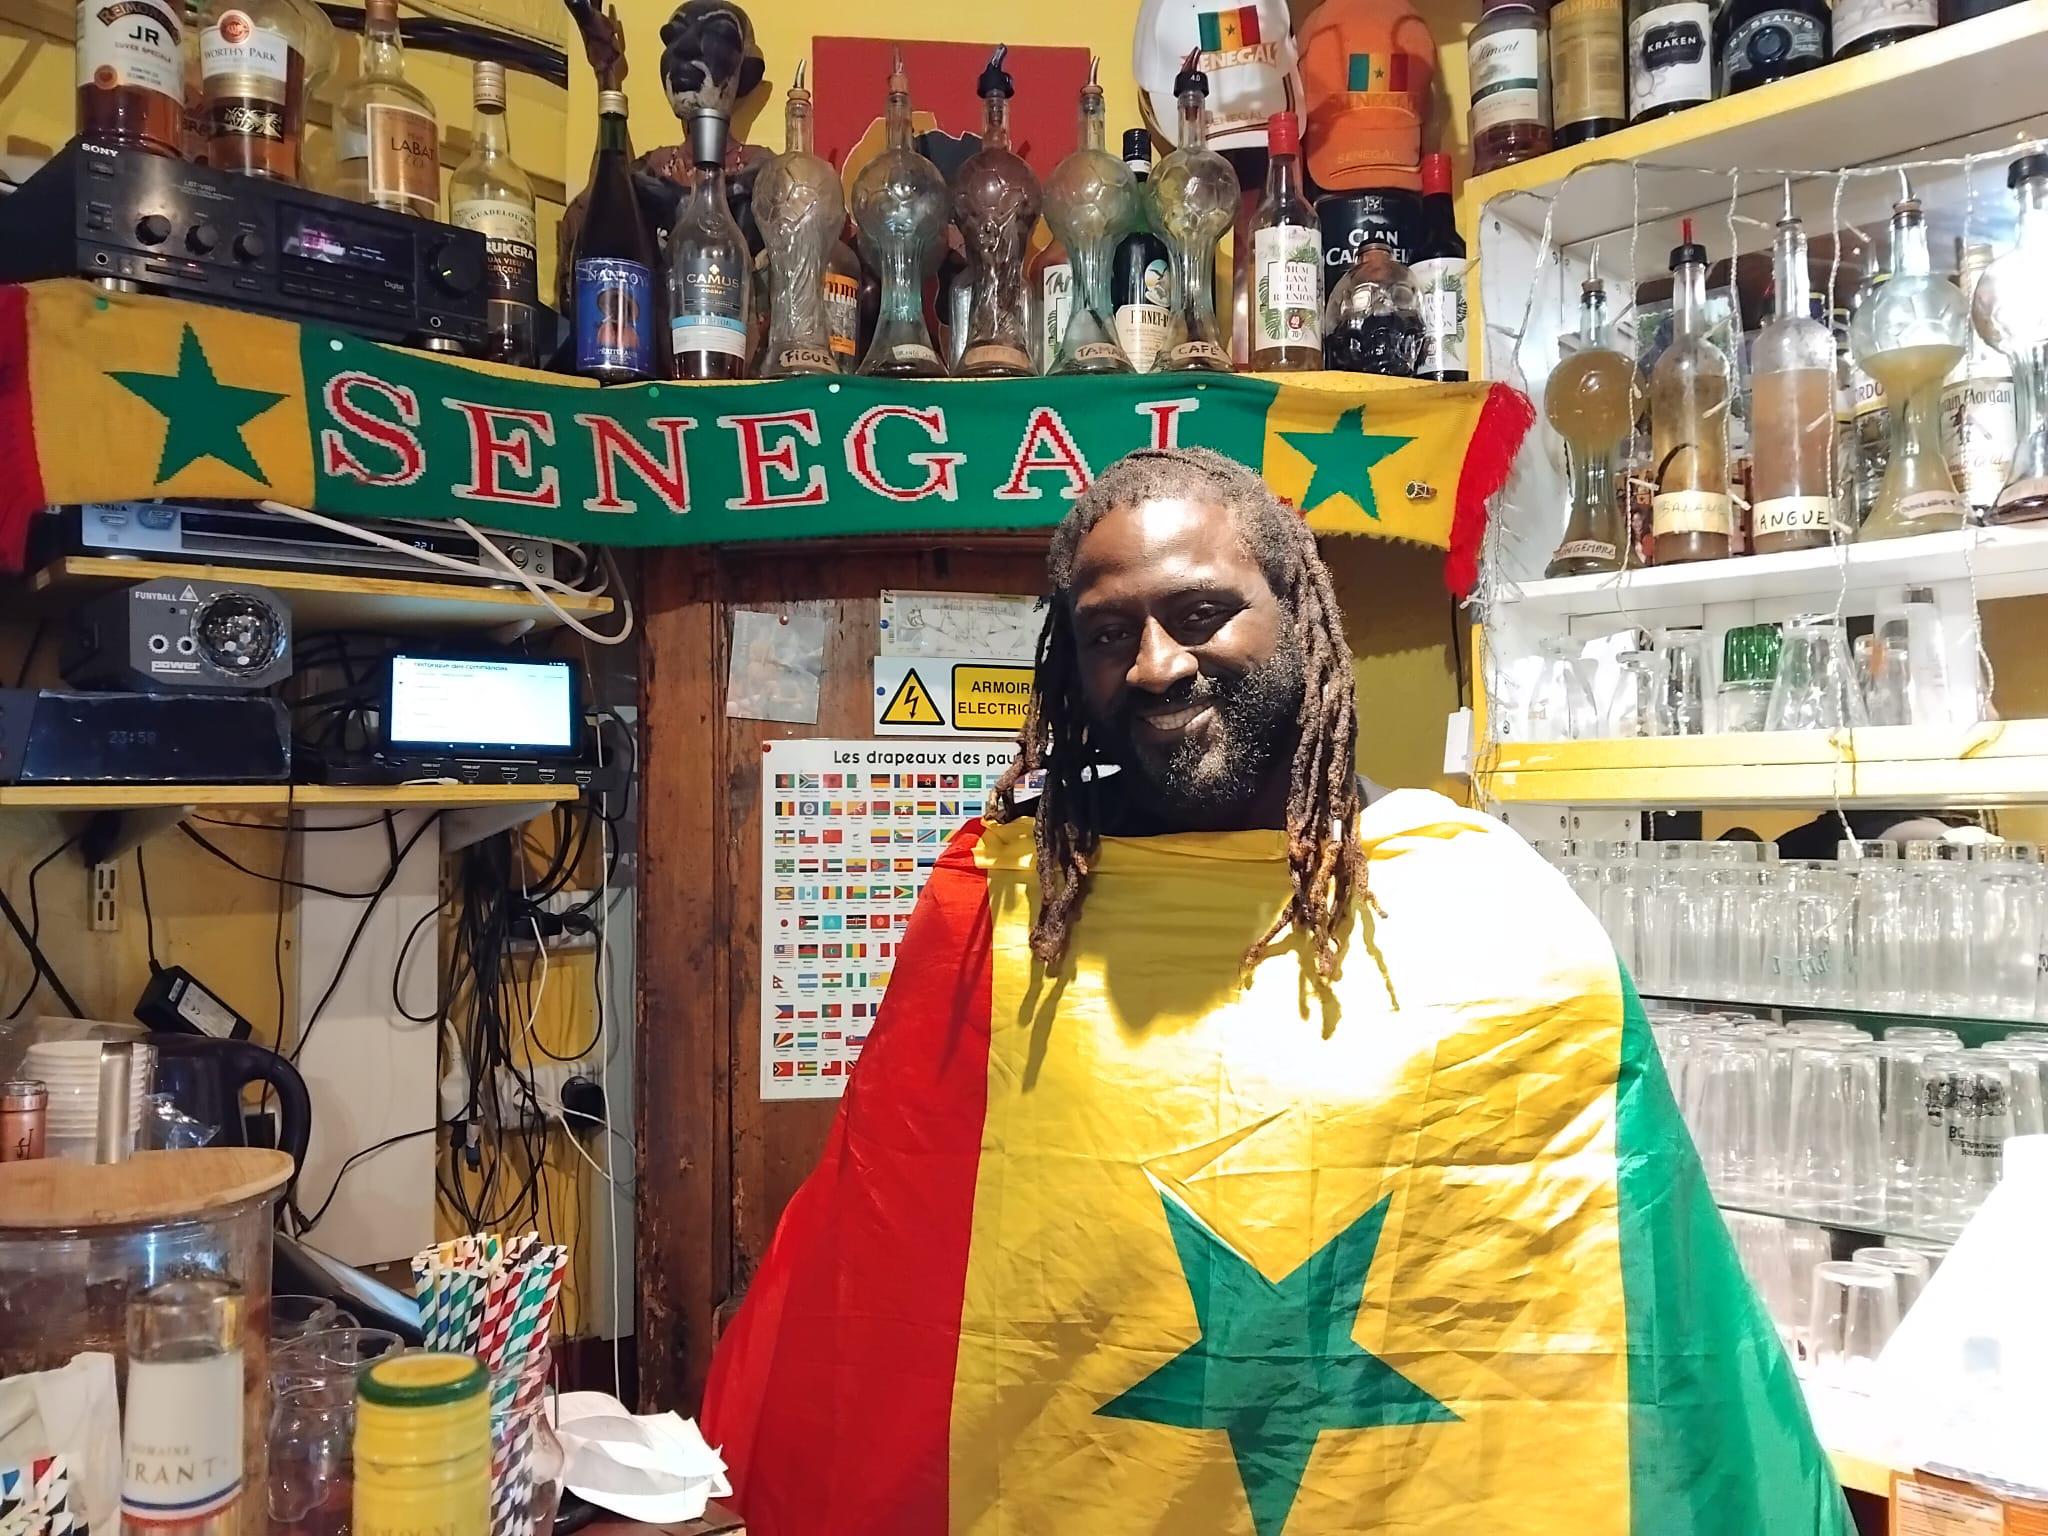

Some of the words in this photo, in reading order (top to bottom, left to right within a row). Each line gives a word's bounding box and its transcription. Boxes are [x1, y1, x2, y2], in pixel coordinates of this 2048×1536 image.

[129, 25, 159, 46] JR
[1647, 36, 1697, 53] KRAKEN
[204, 47, 246, 60] WORTHY
[249, 47, 279, 63] PARK
[1199, 42, 1278, 70] ENEGAL
[81, 142, 119, 158] SONY
[470, 208, 529, 226] GUADELOUPE
[686, 273, 740, 289] CAMUS
[700, 288, 727, 296] COGNAC
[1759, 509, 1830, 530] ANGUE
[135, 591, 177, 601] FUNYBALL
[152, 660, 200, 672] power
[834, 750, 860, 764] Les
[866, 750, 947, 767] drapeaux
[952, 751, 980, 765] des
